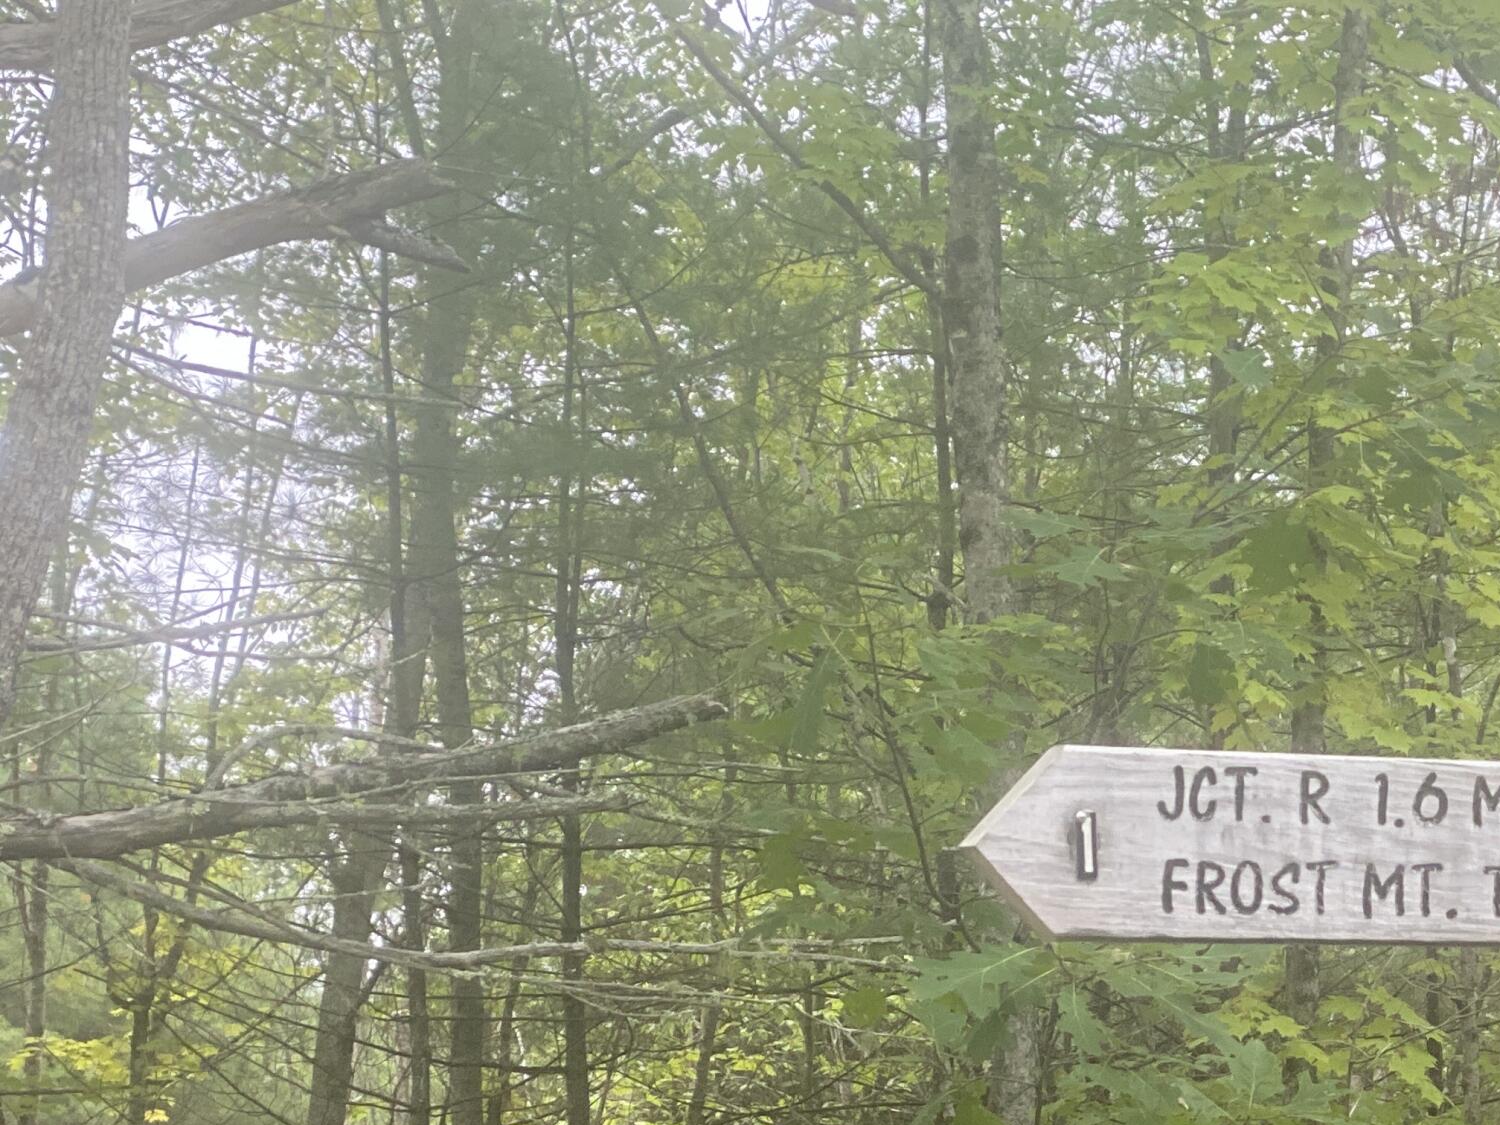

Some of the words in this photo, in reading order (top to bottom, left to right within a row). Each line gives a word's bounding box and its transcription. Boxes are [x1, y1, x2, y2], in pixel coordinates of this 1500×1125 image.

[1157, 765, 1272, 825] JCT.
[1300, 771, 1331, 826] R
[1375, 772, 1449, 829] 1.6
[1160, 858, 1338, 915] FROST
[1362, 863, 1459, 919] MT.
